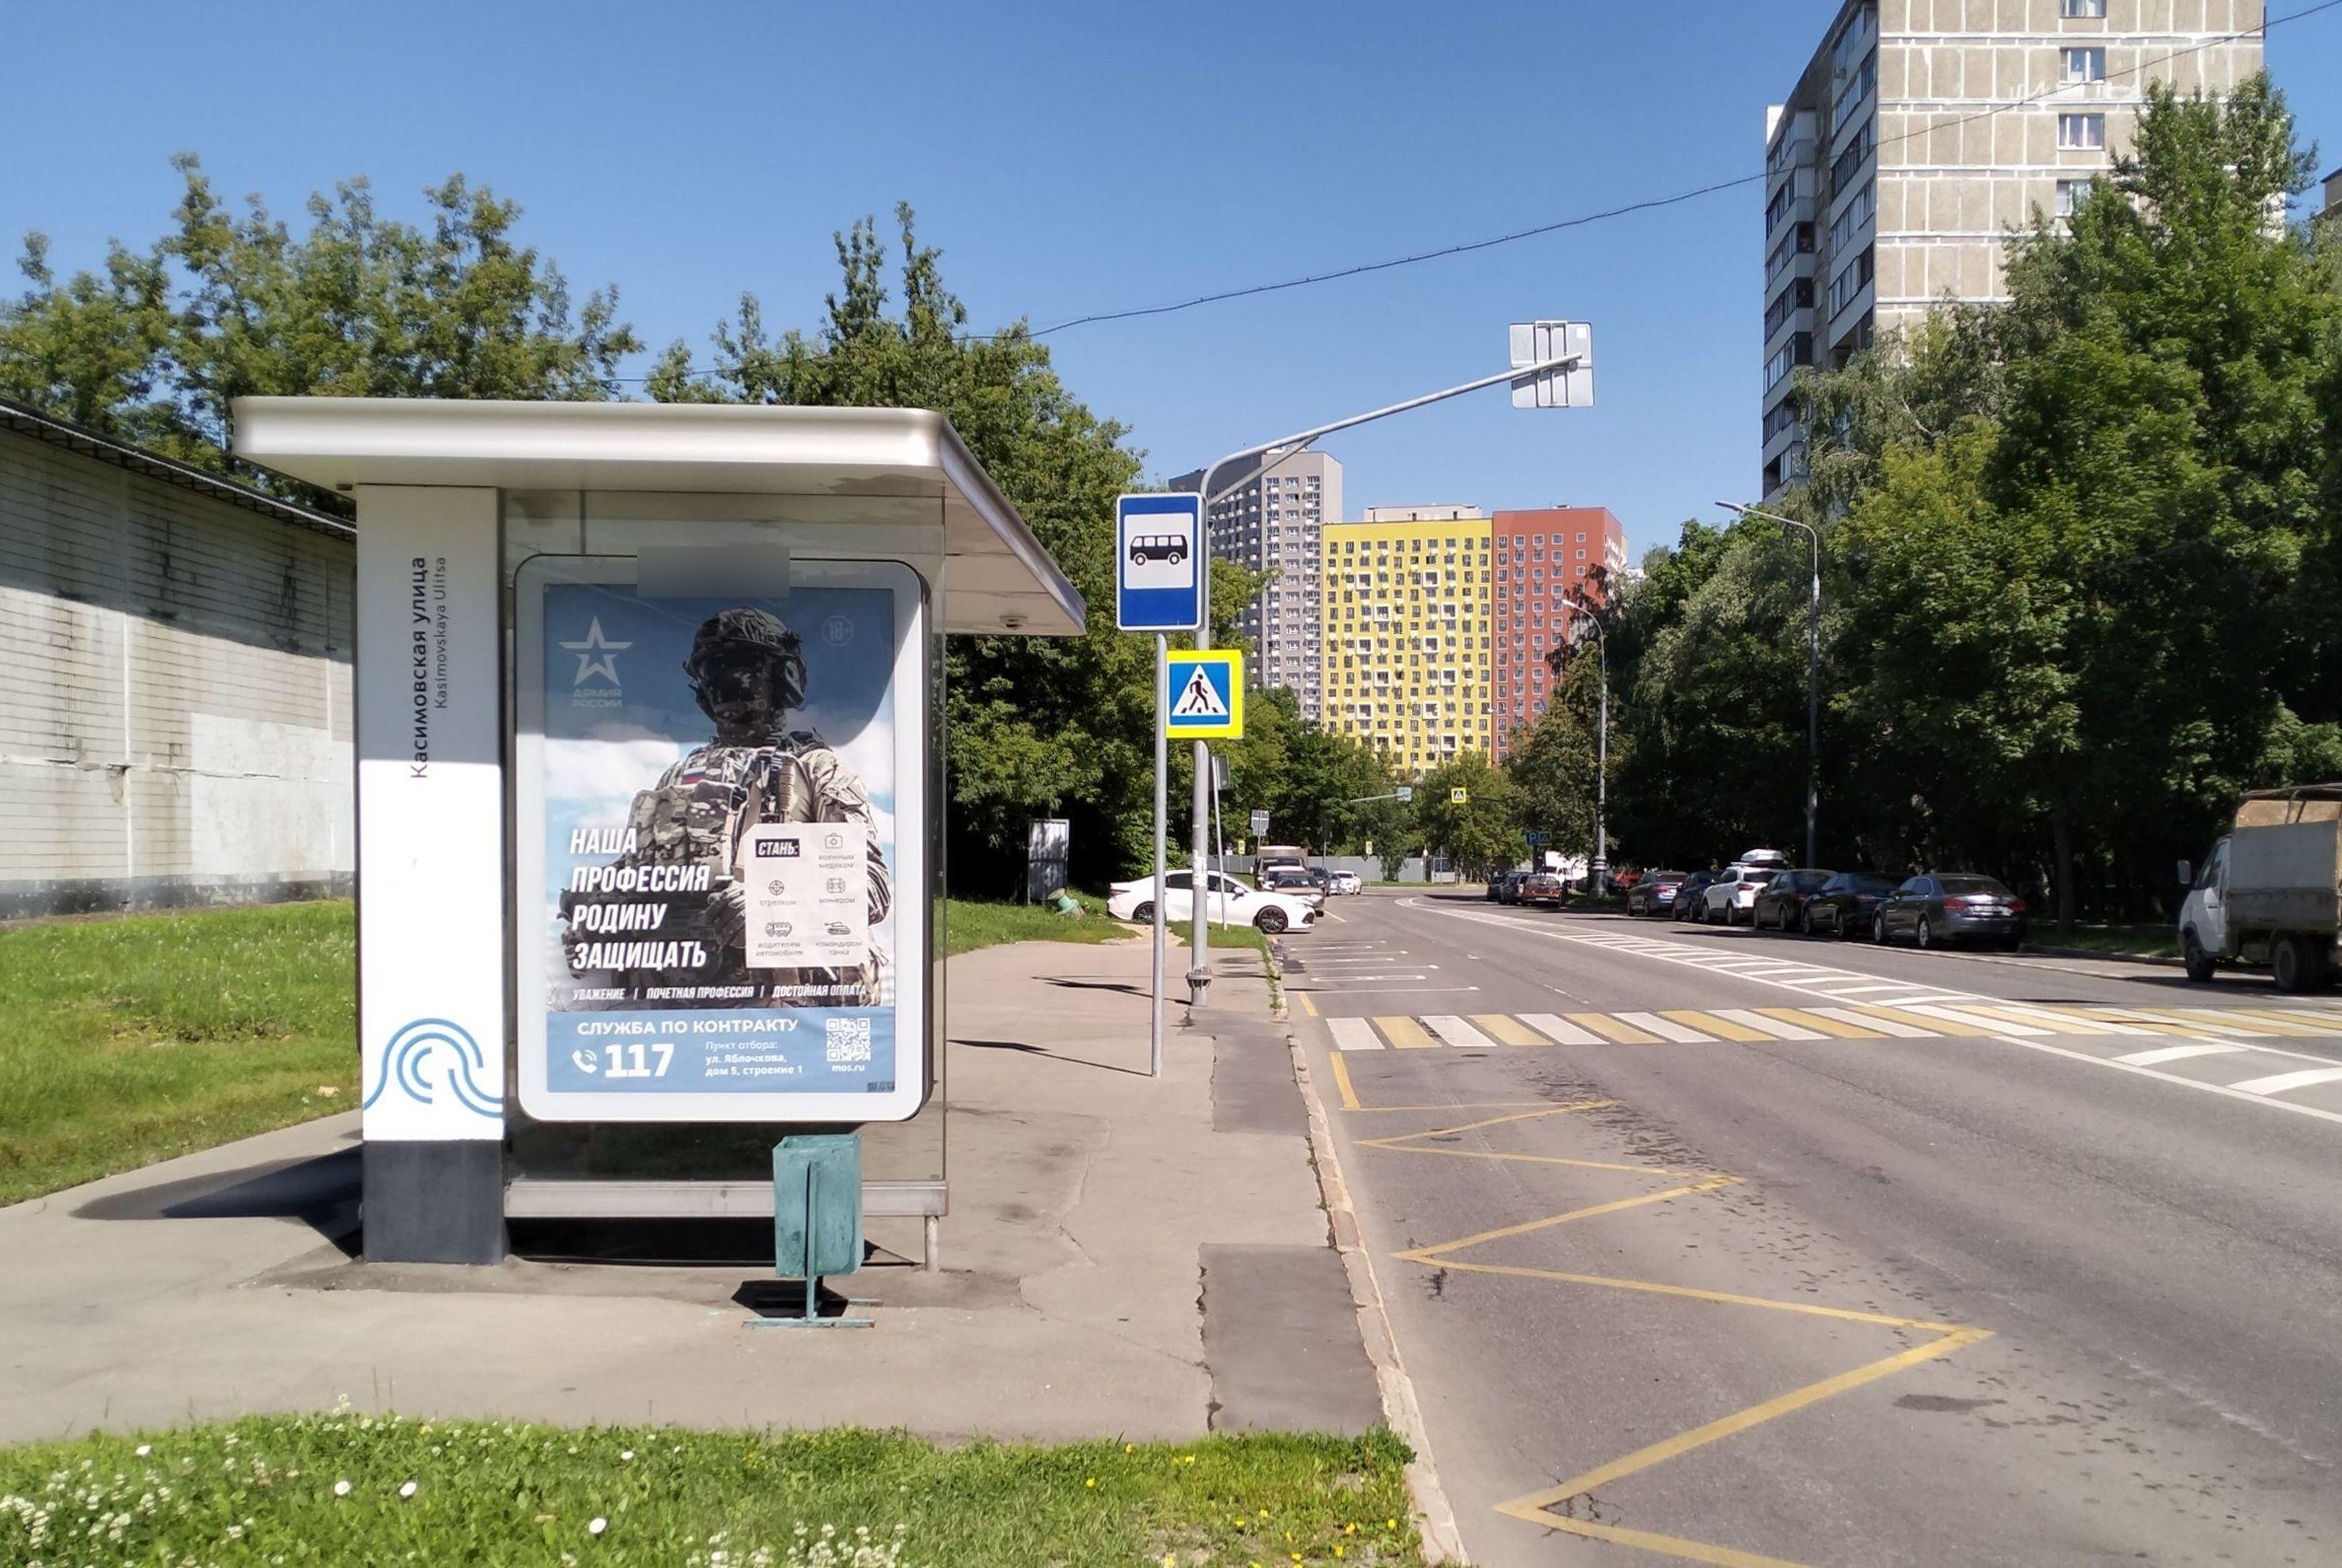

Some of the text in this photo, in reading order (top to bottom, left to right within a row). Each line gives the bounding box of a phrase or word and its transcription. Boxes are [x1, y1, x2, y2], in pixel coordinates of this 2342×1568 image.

[432, 556, 450, 709] Kasimovskaya Ulitsa
[410, 556, 431, 779] Касимовская улица
[570, 827, 637, 854] НАША
[757, 841, 800, 856] СТАНЬ:
[570, 865, 711, 893] ПРОФЕССИЯ
[571, 903, 669, 934] РОДИНУ
[572, 941, 707, 971] ЗАЩИЩАТЬ
[573, 988, 625, 1000] УВАЖЕНИЕ
[646, 985, 754, 1000] ПОЧЕТНАЯ ПРОФЕССИЯ
[772, 984, 868, 998] ДОСТОЙНАЯ ОПЛАТА
[577, 1019, 799, 1035] СЛУЖБА ПО КОНТРАКТУ
[705, 1040, 778, 1052] Пункт отбора:
[604, 1042, 674, 1078] 117
[705, 1054, 787, 1066] ул. Яблочкова,
[705, 1065, 803, 1077] дом 5, строение 1
